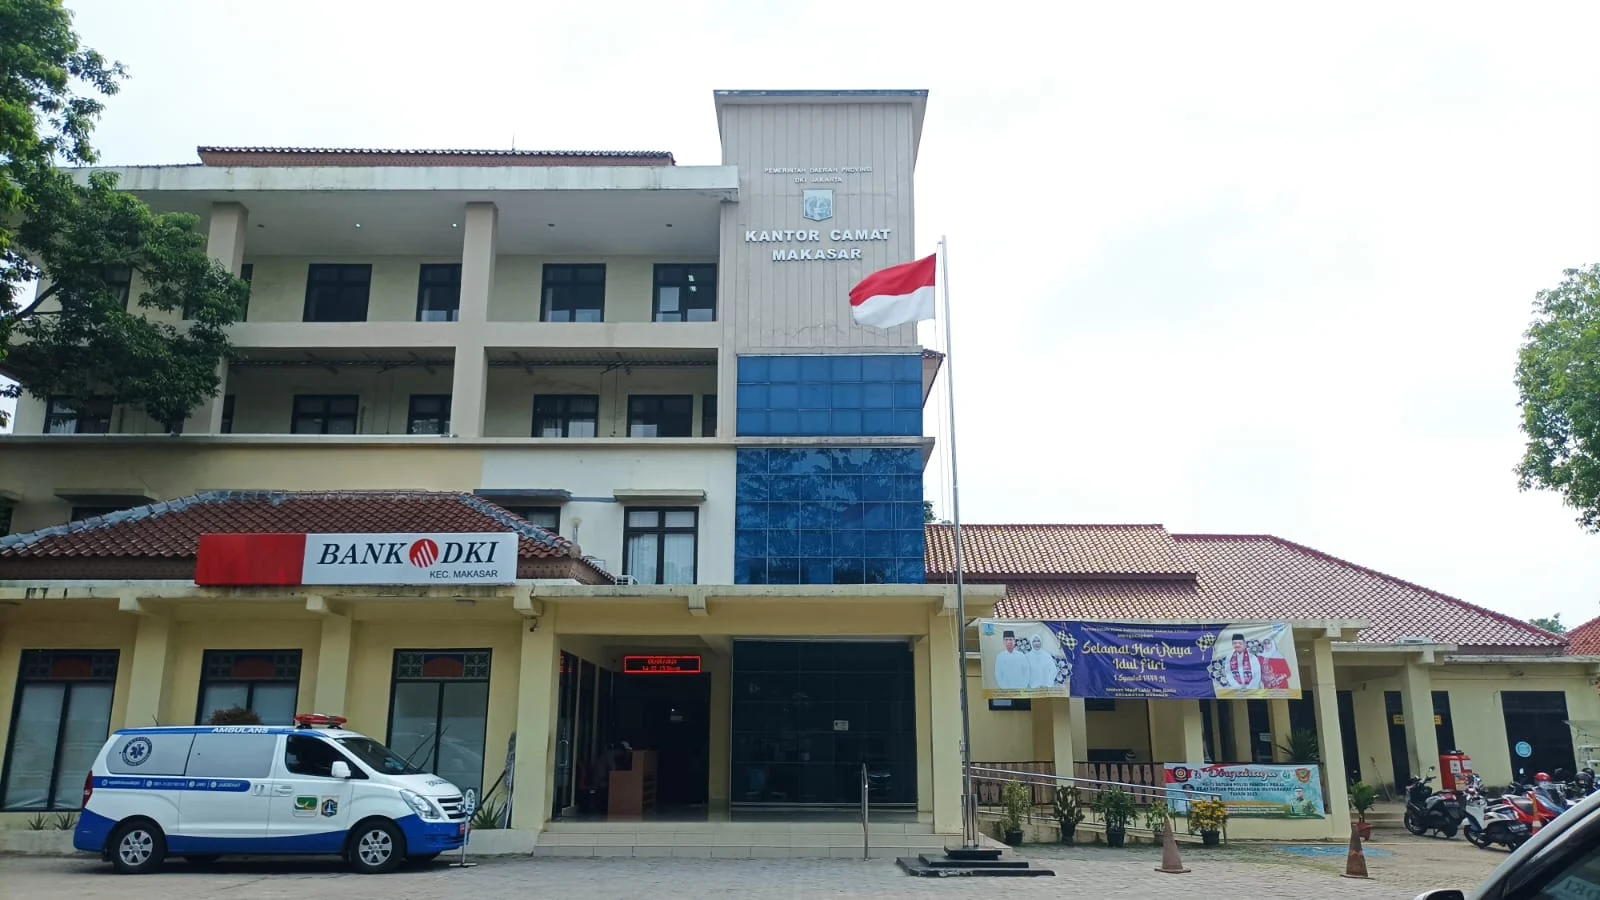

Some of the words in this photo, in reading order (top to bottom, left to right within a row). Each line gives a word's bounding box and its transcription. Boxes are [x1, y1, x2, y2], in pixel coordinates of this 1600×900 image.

[744, 229, 820, 243] KANTOR
[829, 228, 891, 242] CAMAT
[772, 248, 863, 262] MAKASAR
[317, 542, 408, 565] BANK
[440, 541, 500, 564] DKI
[430, 570, 451, 579] KEC.
[453, 569, 499, 579] MAKASAR
[1081, 640, 1130, 655] Selamat
[1130, 643, 1160, 658] Hari
[1158, 640, 1192, 658] Raya
[1113, 658, 1138, 670] Idul
[1140, 658, 1167, 674] Fitri
